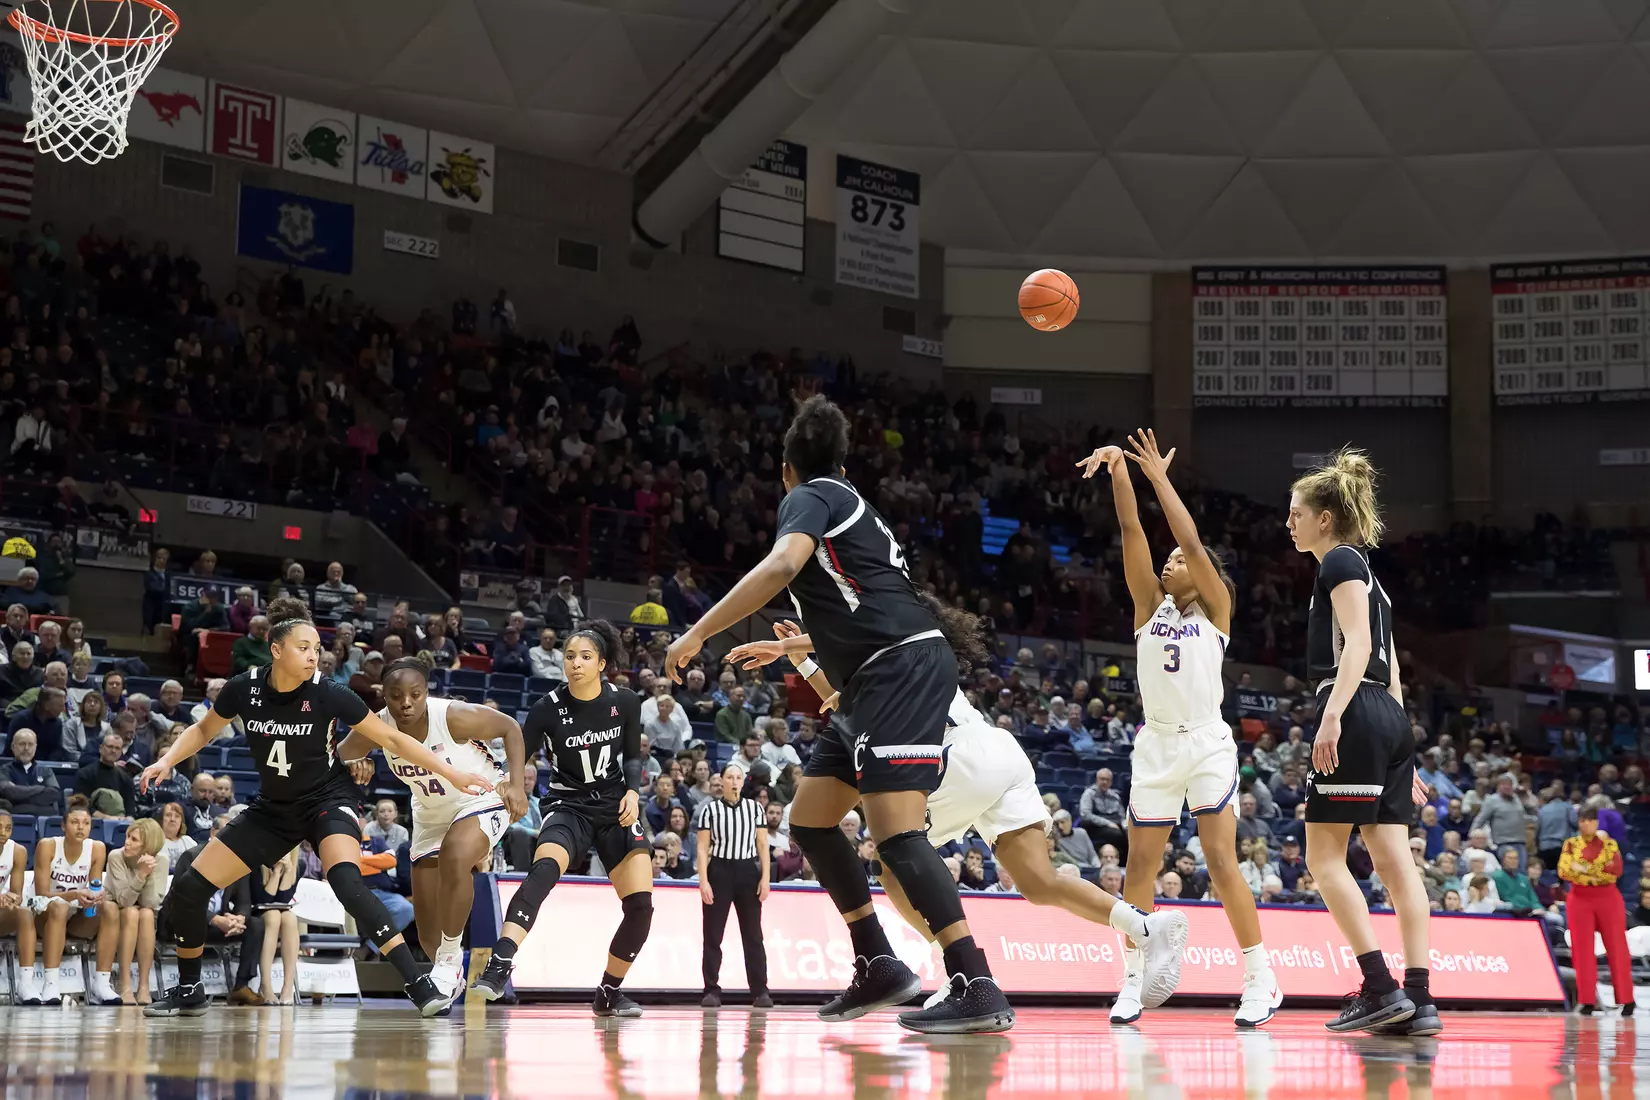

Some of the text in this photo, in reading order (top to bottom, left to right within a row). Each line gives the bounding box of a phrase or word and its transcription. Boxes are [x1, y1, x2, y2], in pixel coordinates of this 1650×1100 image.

[360, 142, 425, 175] Tulsa
[861, 165, 897, 182] COACH
[844, 176, 914, 200] JIM CALHOUN
[851, 195, 905, 231] 873
[408, 238, 437, 255] 222
[1198, 285, 1442, 296] REGULAR SEASON CHAMPIONS
[1307, 301, 1331, 316] 1994
[1416, 301, 1442, 316] 1997
[1306, 326, 1332, 341] 2001
[1342, 326, 1370, 341] 2002
[1415, 326, 1443, 341] 2004
[1197, 351, 1224, 366] 2007
[1306, 351, 1333, 366] 2010
[1343, 351, 1370, 366] 2011
[1378, 351, 1406, 366] 2014
[1415, 351, 1443, 366] 2015
[1197, 375, 1224, 391] 2016
[1234, 375, 1260, 391] 2017
[1194, 398, 1286, 407] CONNECTICUT
[190, 499, 257, 519] SEC 221
[178, 585, 204, 597] SEC
[1150, 622, 1200, 640] UCONN
[1164, 644, 1180, 673] 3
[250, 686, 261, 695] RJ
[558, 707, 568, 716] RJ
[1260, 695, 1277, 711] 12
[247, 719, 313, 736] CINCINNATI
[565, 726, 621, 748] CINCINNATI
[266, 740, 292, 777] 4
[579, 745, 611, 783] 14
[413, 779, 446, 797] 14
[50, 870, 87, 884] UCONN
[1001, 936, 1113, 962] Insurance
[1428, 948, 1510, 973] Services
